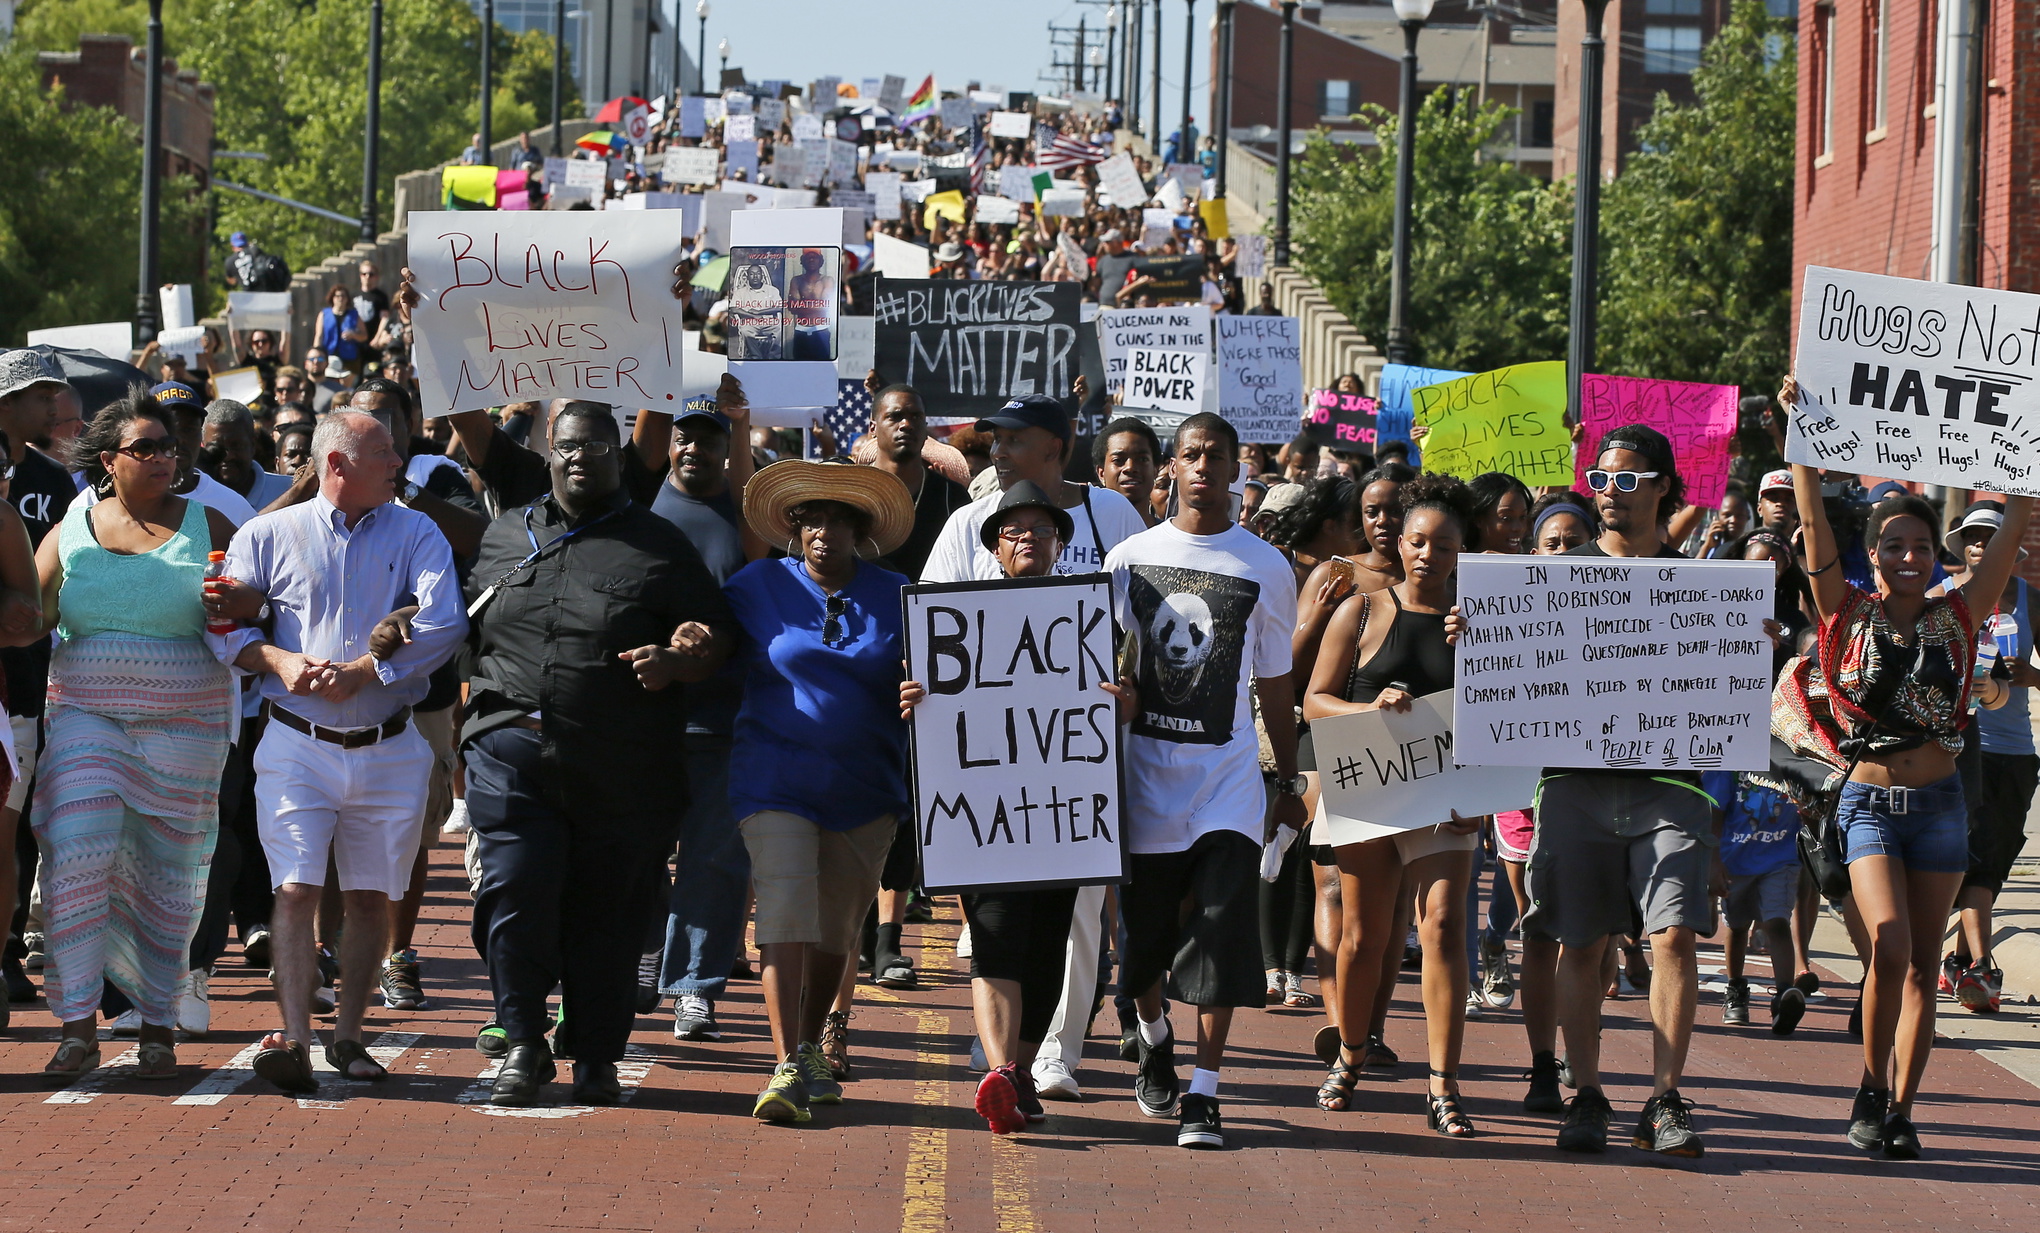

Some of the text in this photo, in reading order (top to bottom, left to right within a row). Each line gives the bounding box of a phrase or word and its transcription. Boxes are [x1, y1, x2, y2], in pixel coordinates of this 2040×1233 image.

[438, 233, 638, 323] BLACK
[736, 300, 830, 308] BLACK LIVES MATTER!!
[876, 284, 1055, 327] #BLACKLIVES
[731, 318, 780, 326] MURDERED
[796, 318, 831, 326] POLICE!!
[1170, 316, 1191, 327] ARE
[1220, 319, 1290, 338] WHERE
[1116, 333, 1203, 346] GUNS IN THE
[1221, 345, 1300, 360] WERE THOSE
[905, 322, 1077, 398] MATTER
[1135, 351, 1195, 375] BLACK
[155, 388, 193, 401] NAACP
[1133, 377, 1194, 400] POWER
[1313, 389, 1338, 407] NO
[1849, 362, 2011, 427] HATE
[1336, 423, 1376, 443] PEAC
[1795, 411, 2020, 455] Free Free Free Free
[1813, 430, 2031, 480] Hugs! Hugs! Hugs! Hugs!
[1973, 480, 2040, 496] #BlackLivesMatte
[1525, 566, 1677, 585] IN MEMORY OF
[1464, 593, 1533, 619] DARIUS
[1547, 590, 1632, 613] ROBINSON
[1519, 621, 1565, 640] VISTA
[1585, 617, 1652, 641] HOMICIDE
[1670, 612, 1716, 630] CUSTER
[926, 600, 1110, 695] BLACK
[1464, 653, 1524, 677] MICHAEL
[1536, 649, 1568, 669] HALL
[1582, 642, 1669, 663] QUESTIONABLE
[1464, 676, 1767, 705] CARMEN YBARRA KILLED BY CARNEGIE POLICE
[1145, 711, 1205, 733] PANDA
[1490, 720, 1582, 744] VICTIMS
[1638, 713, 1677, 732] POLICE
[1688, 712, 1751, 730] BRUTALITY
[956, 704, 1111, 769] LIVES
[1332, 730, 1455, 790] #WEM
